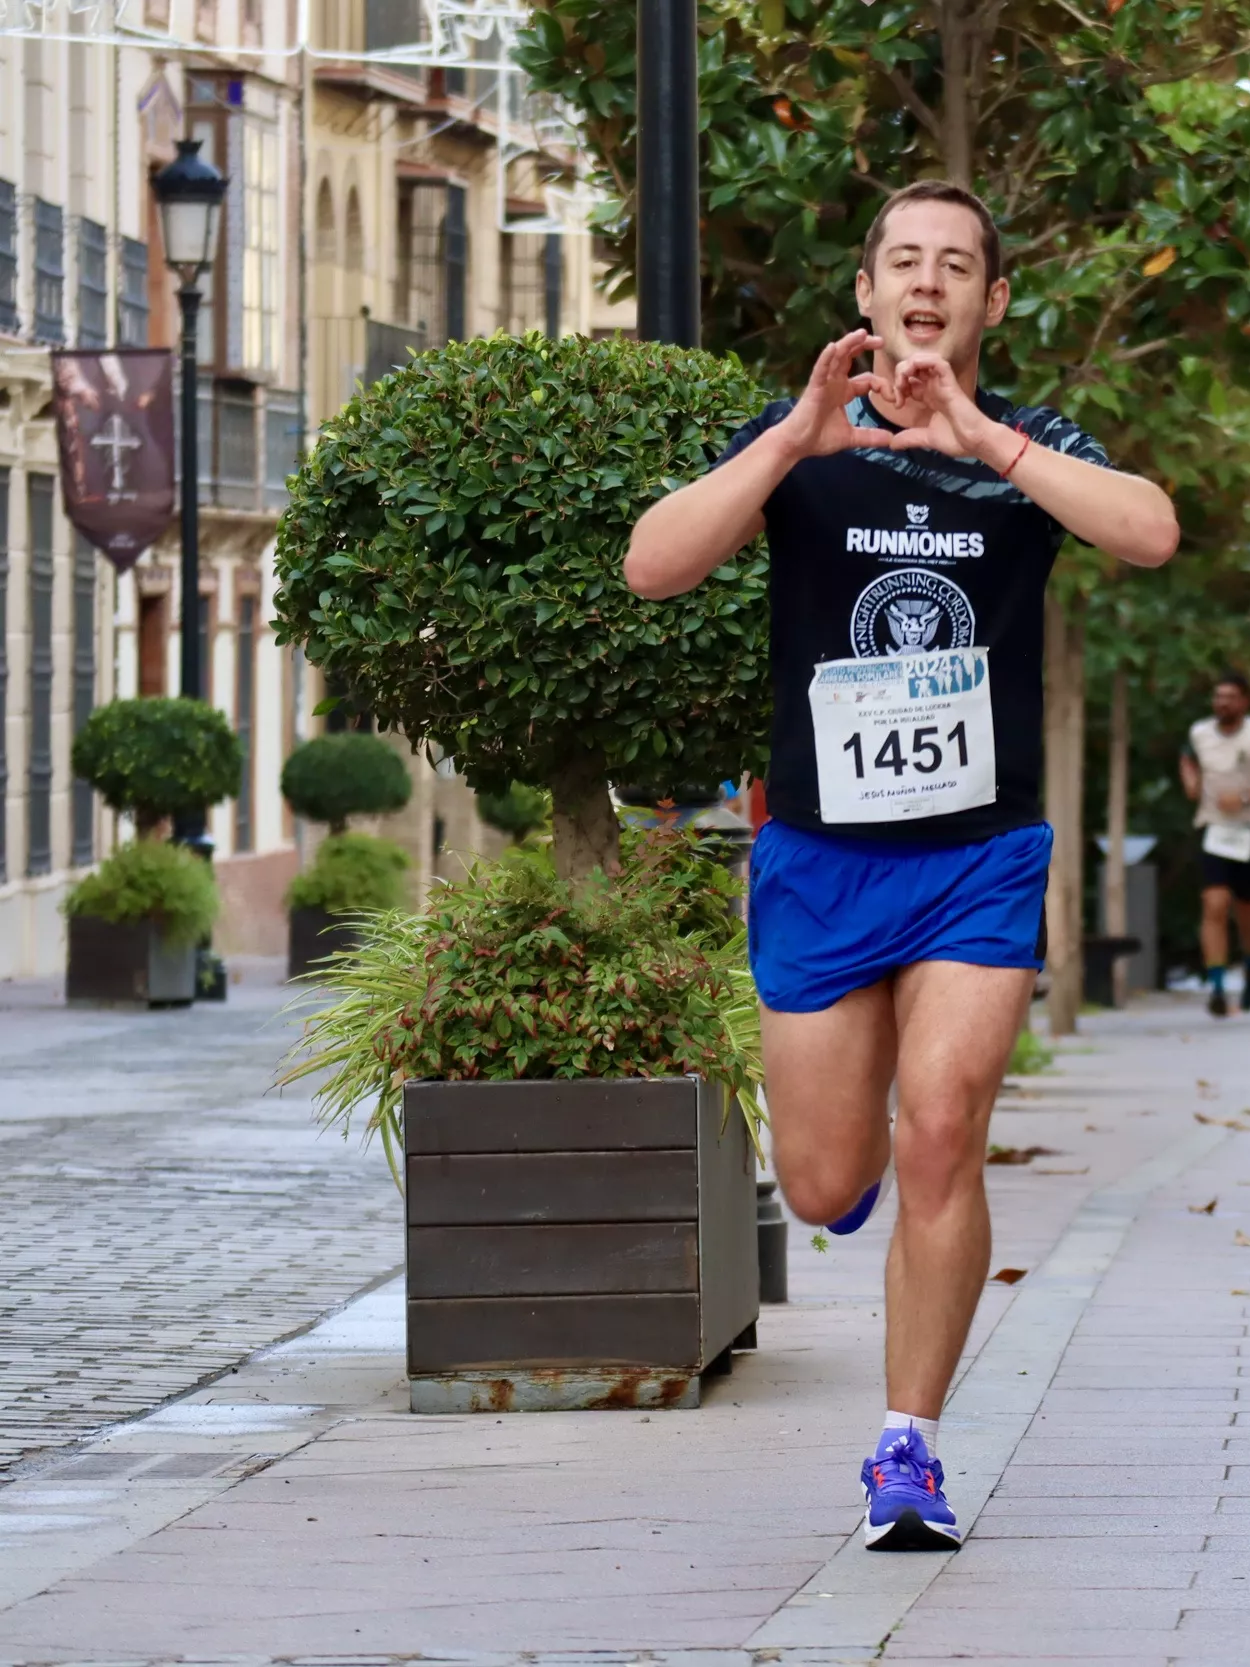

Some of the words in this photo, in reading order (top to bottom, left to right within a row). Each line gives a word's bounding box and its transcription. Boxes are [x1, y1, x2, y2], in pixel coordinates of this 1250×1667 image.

[846, 527, 985, 558] RUNMONES
[903, 654, 954, 679] 2024
[889, 716, 899, 724] LA
[843, 721, 969, 779] 1451
